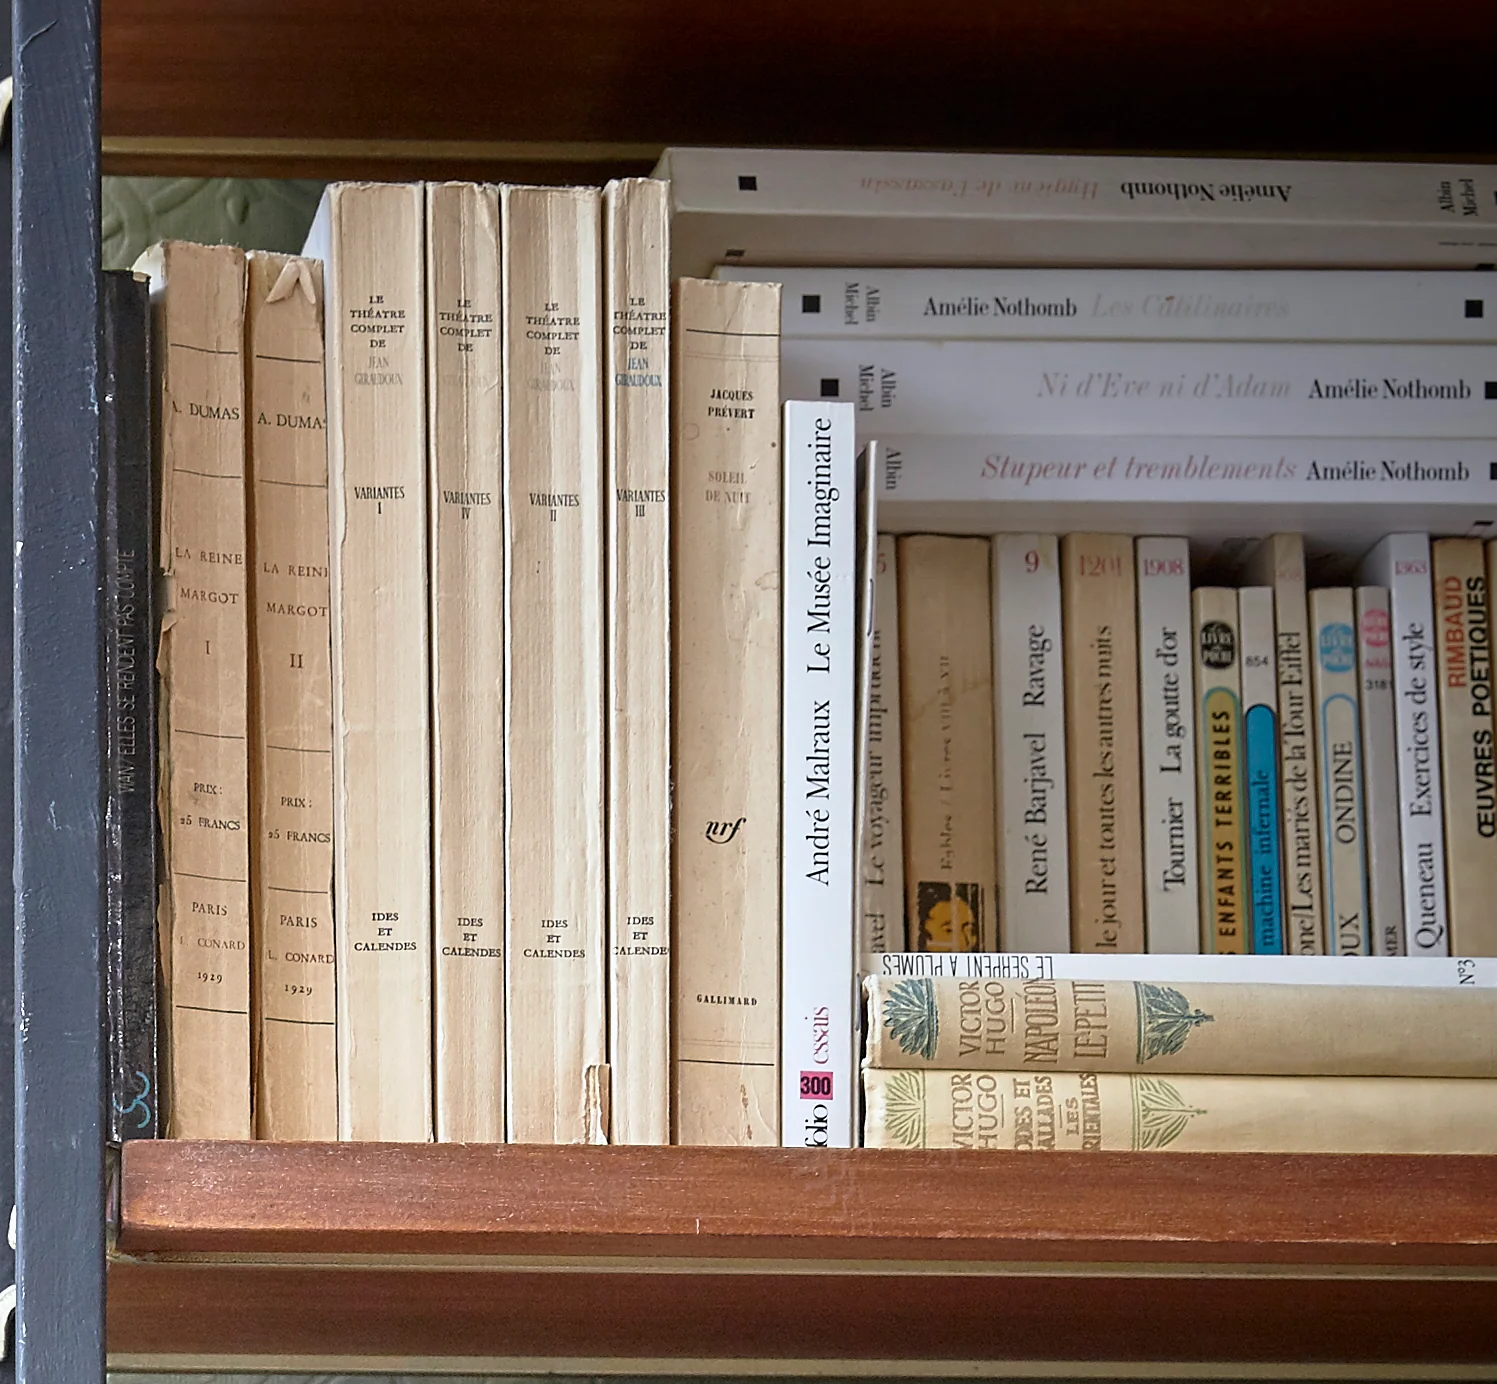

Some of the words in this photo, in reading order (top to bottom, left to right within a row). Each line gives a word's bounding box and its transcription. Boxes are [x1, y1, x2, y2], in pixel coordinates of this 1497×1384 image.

[350, 309, 405, 319] THÉATRE
[350, 325, 405, 334] COMPLET
[923, 296, 988, 318] Amélie
[993, 297, 1077, 318] Nothomb
[708, 406, 755, 419] PRÉVERT
[710, 389, 753, 401] JACQUES
[1309, 379, 1377, 400] Amélie
[1383, 378, 1472, 400] Nothomb
[354, 486, 405, 499] VARIANTES
[805, 418, 839, 519] Imaginaire
[981, 454, 1086, 484] Stupeur
[1093, 458, 1119, 480] et
[1124, 457, 1296, 482] tremblements
[1306, 461, 1375, 482] Amélie
[1381, 461, 1470, 482] Nothomb
[804, 528, 832, 623] Musée
[807, 631, 832, 673] Le
[1403, 622, 1434, 663] style
[1444, 576, 1466, 688] RIMBAUD
[1467, 576, 1491, 718] POETIQUES
[1023, 625, 1051, 708] Ravage
[1405, 674, 1428, 701] de
[1164, 674, 1187, 738] goutte
[804, 699, 832, 800] Malraux
[1160, 744, 1182, 774] La
[1212, 711, 1233, 828] TERRIBLES
[1408, 708, 1431, 818] Exercices
[1024, 733, 1054, 826] Barjavel
[1332, 741, 1356, 843] ONDINE
[1475, 729, 1496, 838] ŒUVRES
[706, 816, 746, 844] nrf
[804, 809, 832, 886] André
[1162, 798, 1185, 891] Tournier
[1026, 834, 1048, 895] René
[1217, 841, 1235, 939] ENFANTS
[1414, 842, 1443, 949] Queneau
[372, 913, 398, 921] IDES
[378, 928, 392, 936] ET
[355, 942, 416, 952] CALENDES
[285, 984, 312, 995] 1929
[696, 995, 757, 1008] GALLIMARD
[804, 1006, 829, 1064] essais
[959, 980, 982, 1057] VICTOR
[984, 981, 1006, 1055] HUGO
[801, 1076, 831, 1095] 300
